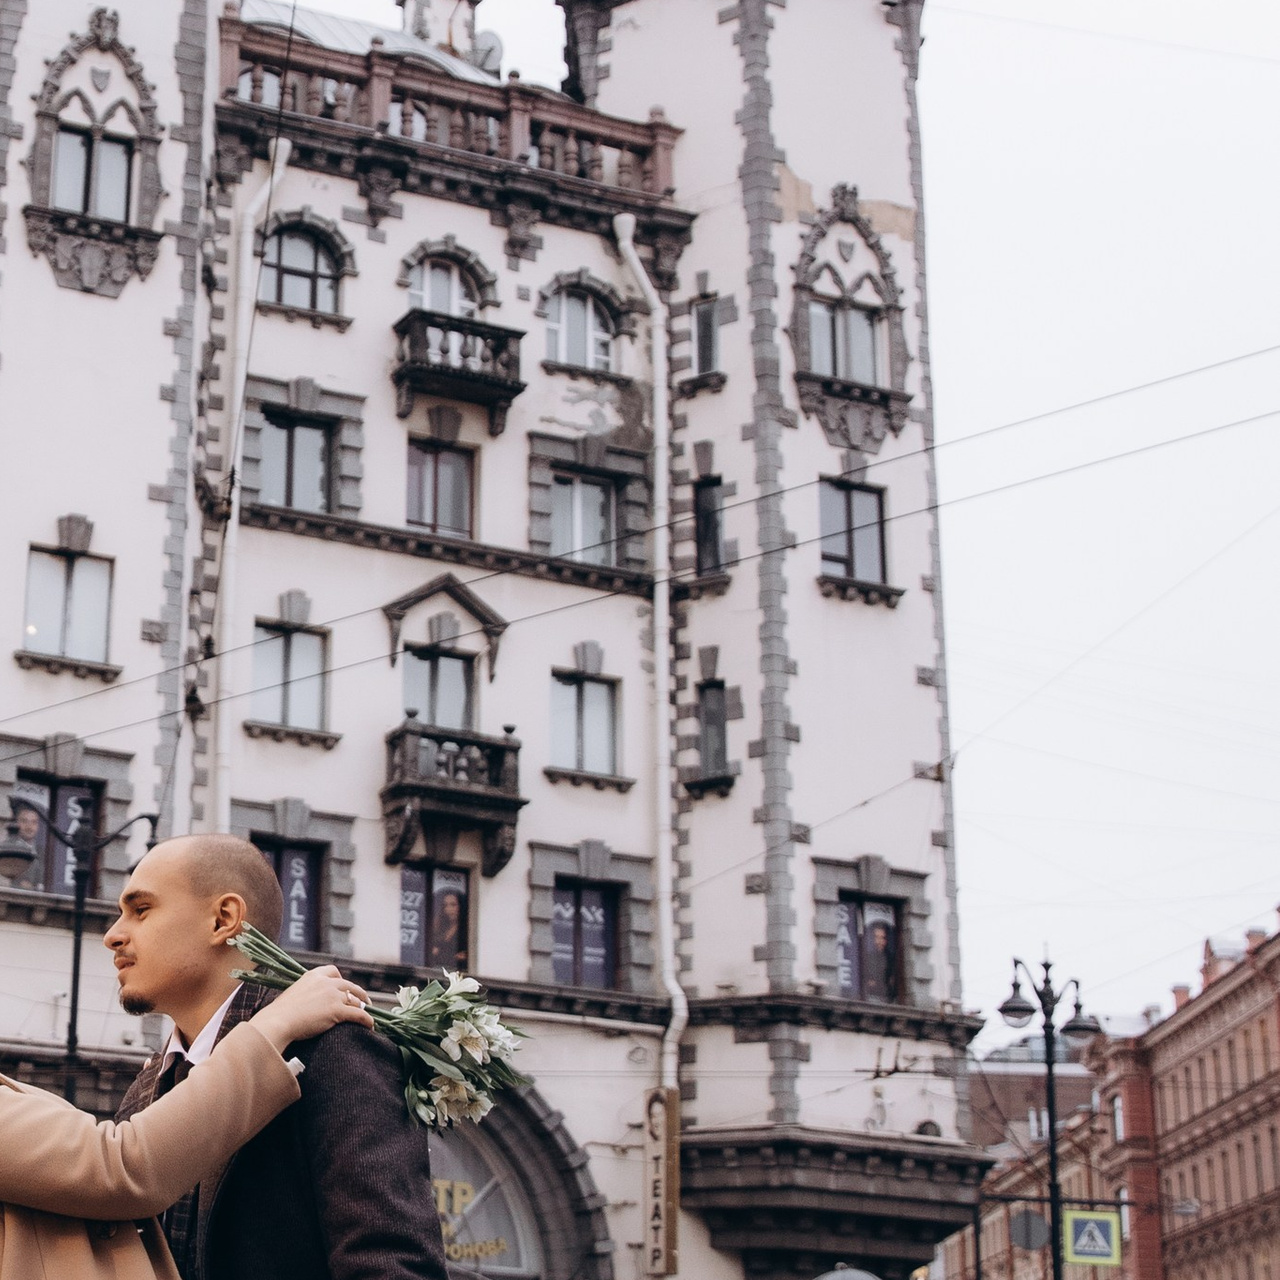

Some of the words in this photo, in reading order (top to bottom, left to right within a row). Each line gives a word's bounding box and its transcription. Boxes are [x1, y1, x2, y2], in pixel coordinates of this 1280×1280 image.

[289, 858, 307, 941] SALE
[837, 904, 852, 987] SALE
[651, 1155, 662, 1267] ТЕАТР
